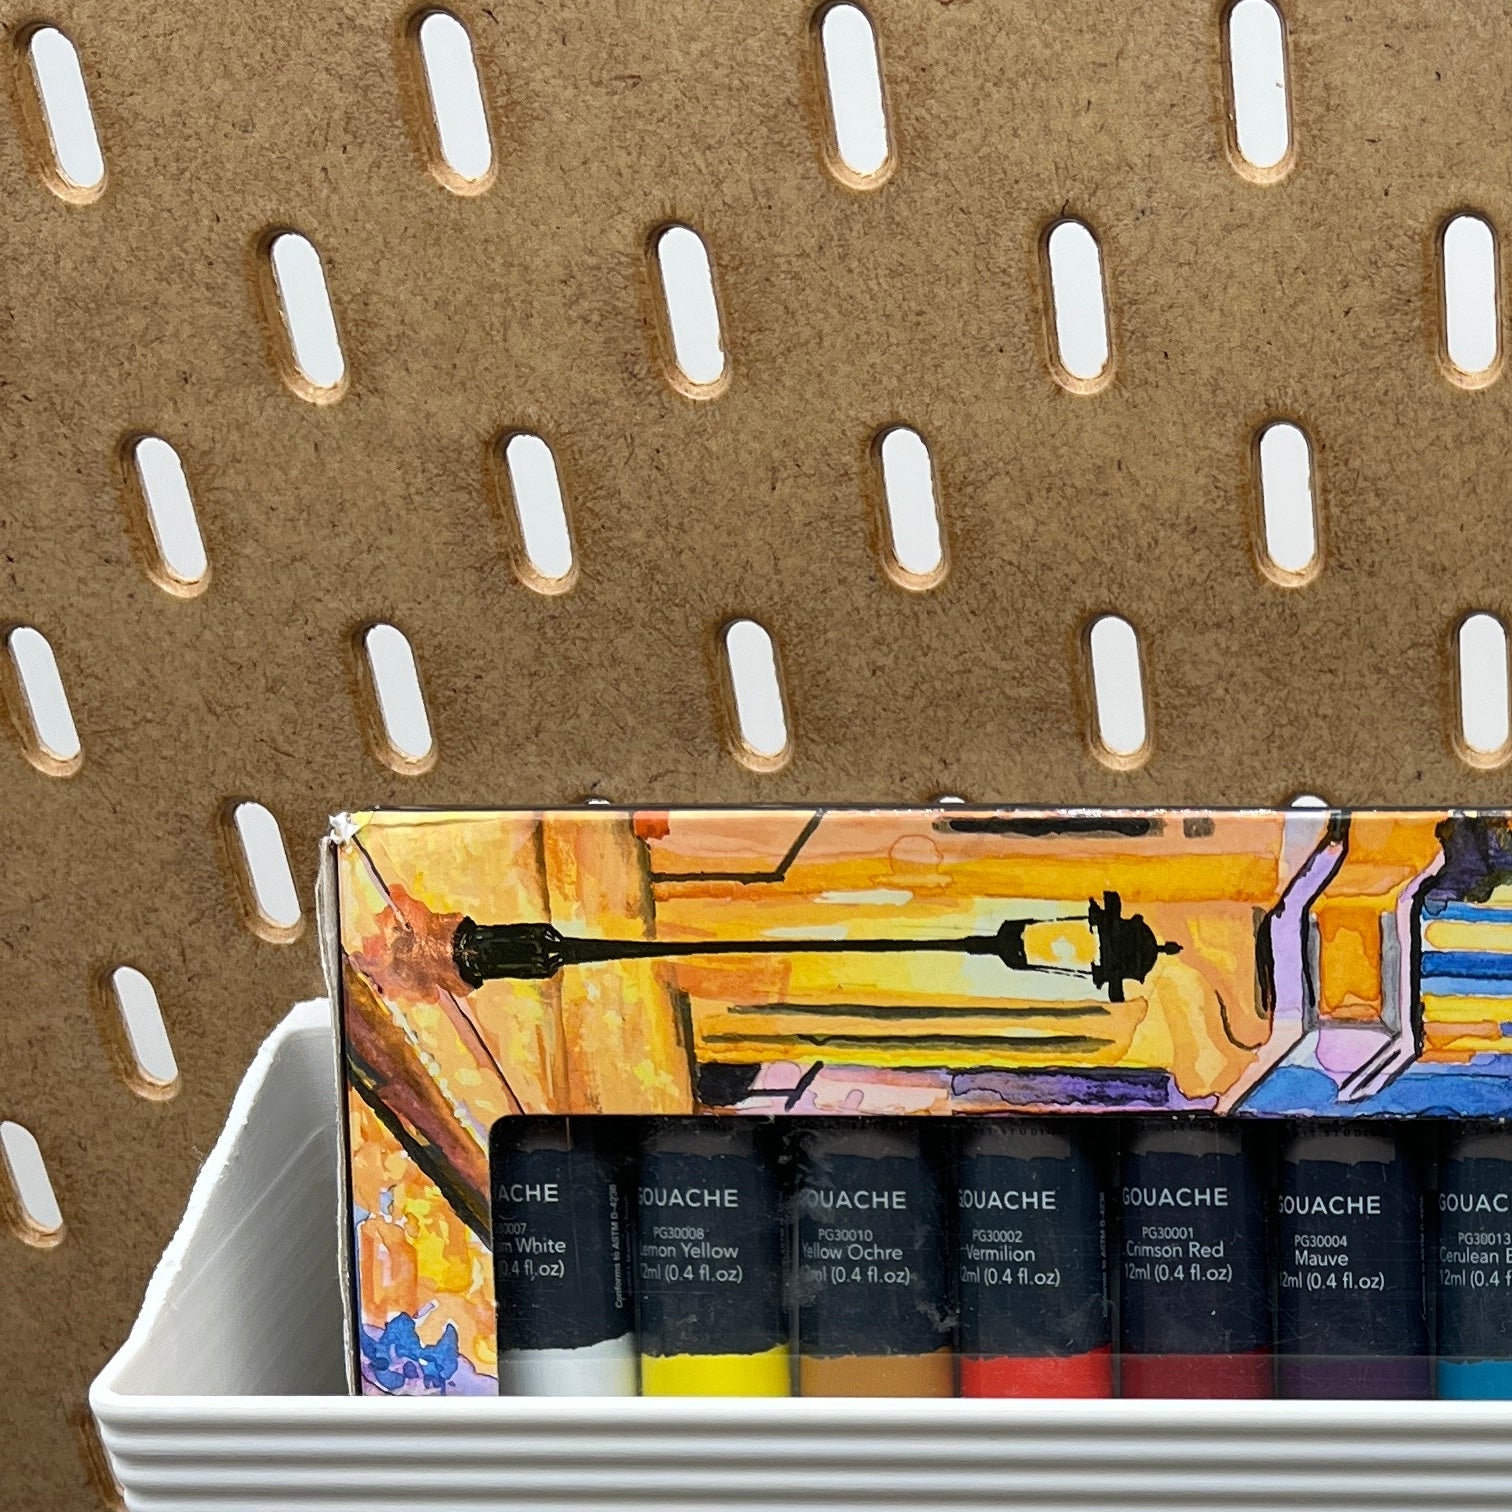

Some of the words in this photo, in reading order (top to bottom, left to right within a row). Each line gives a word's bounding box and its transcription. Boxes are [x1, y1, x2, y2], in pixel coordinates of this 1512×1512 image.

[495, 1183, 560, 1203] ACHE
[807, 1190, 907, 1210] OUACHE
[1122, 1186, 1229, 1208] GOUACHE
[818, 1229, 873, 1242] PG30010
[972, 1230, 1022, 1243] PG30002
[1142, 1226, 1194, 1240] PG30001
[1294, 1235, 1348, 1248] PG30004
[1457, 1232, 1512, 1246] PG30013
[515, 1237, 567, 1254] White
[680, 1242, 739, 1259] Yellow
[802, 1242, 843, 1260] Yellow
[847, 1243, 903, 1260] Ochre
[966, 1243, 1036, 1262] Vermilion
[1126, 1240, 1183, 1258] Crimson
[1188, 1240, 1225, 1258] Red
[1295, 1249, 1349, 1267] Mauve
[1439, 1246, 1501, 1265] Cerulean
[640, 1263, 661, 1280] 2ml
[665, 1264, 694, 1283] (0.4
[700, 1264, 743, 1284] fl.oz)
[802, 1265, 826, 1282] 2ml
[831, 1266, 861, 1285] (0.4
[867, 1266, 911, 1285] fl.oz)
[961, 1267, 980, 1284] 2ml
[984, 1268, 1013, 1286] (0.4
[1018, 1268, 1061, 1287] fl.oz)
[1154, 1263, 1184, 1283] (0.4
[1190, 1262, 1233, 1283] fl.oz)
[1306, 1273, 1336, 1291] (0.4
[1342, 1272, 1386, 1291] fl.oz)
[1470, 1269, 1501, 1290] (0.4
